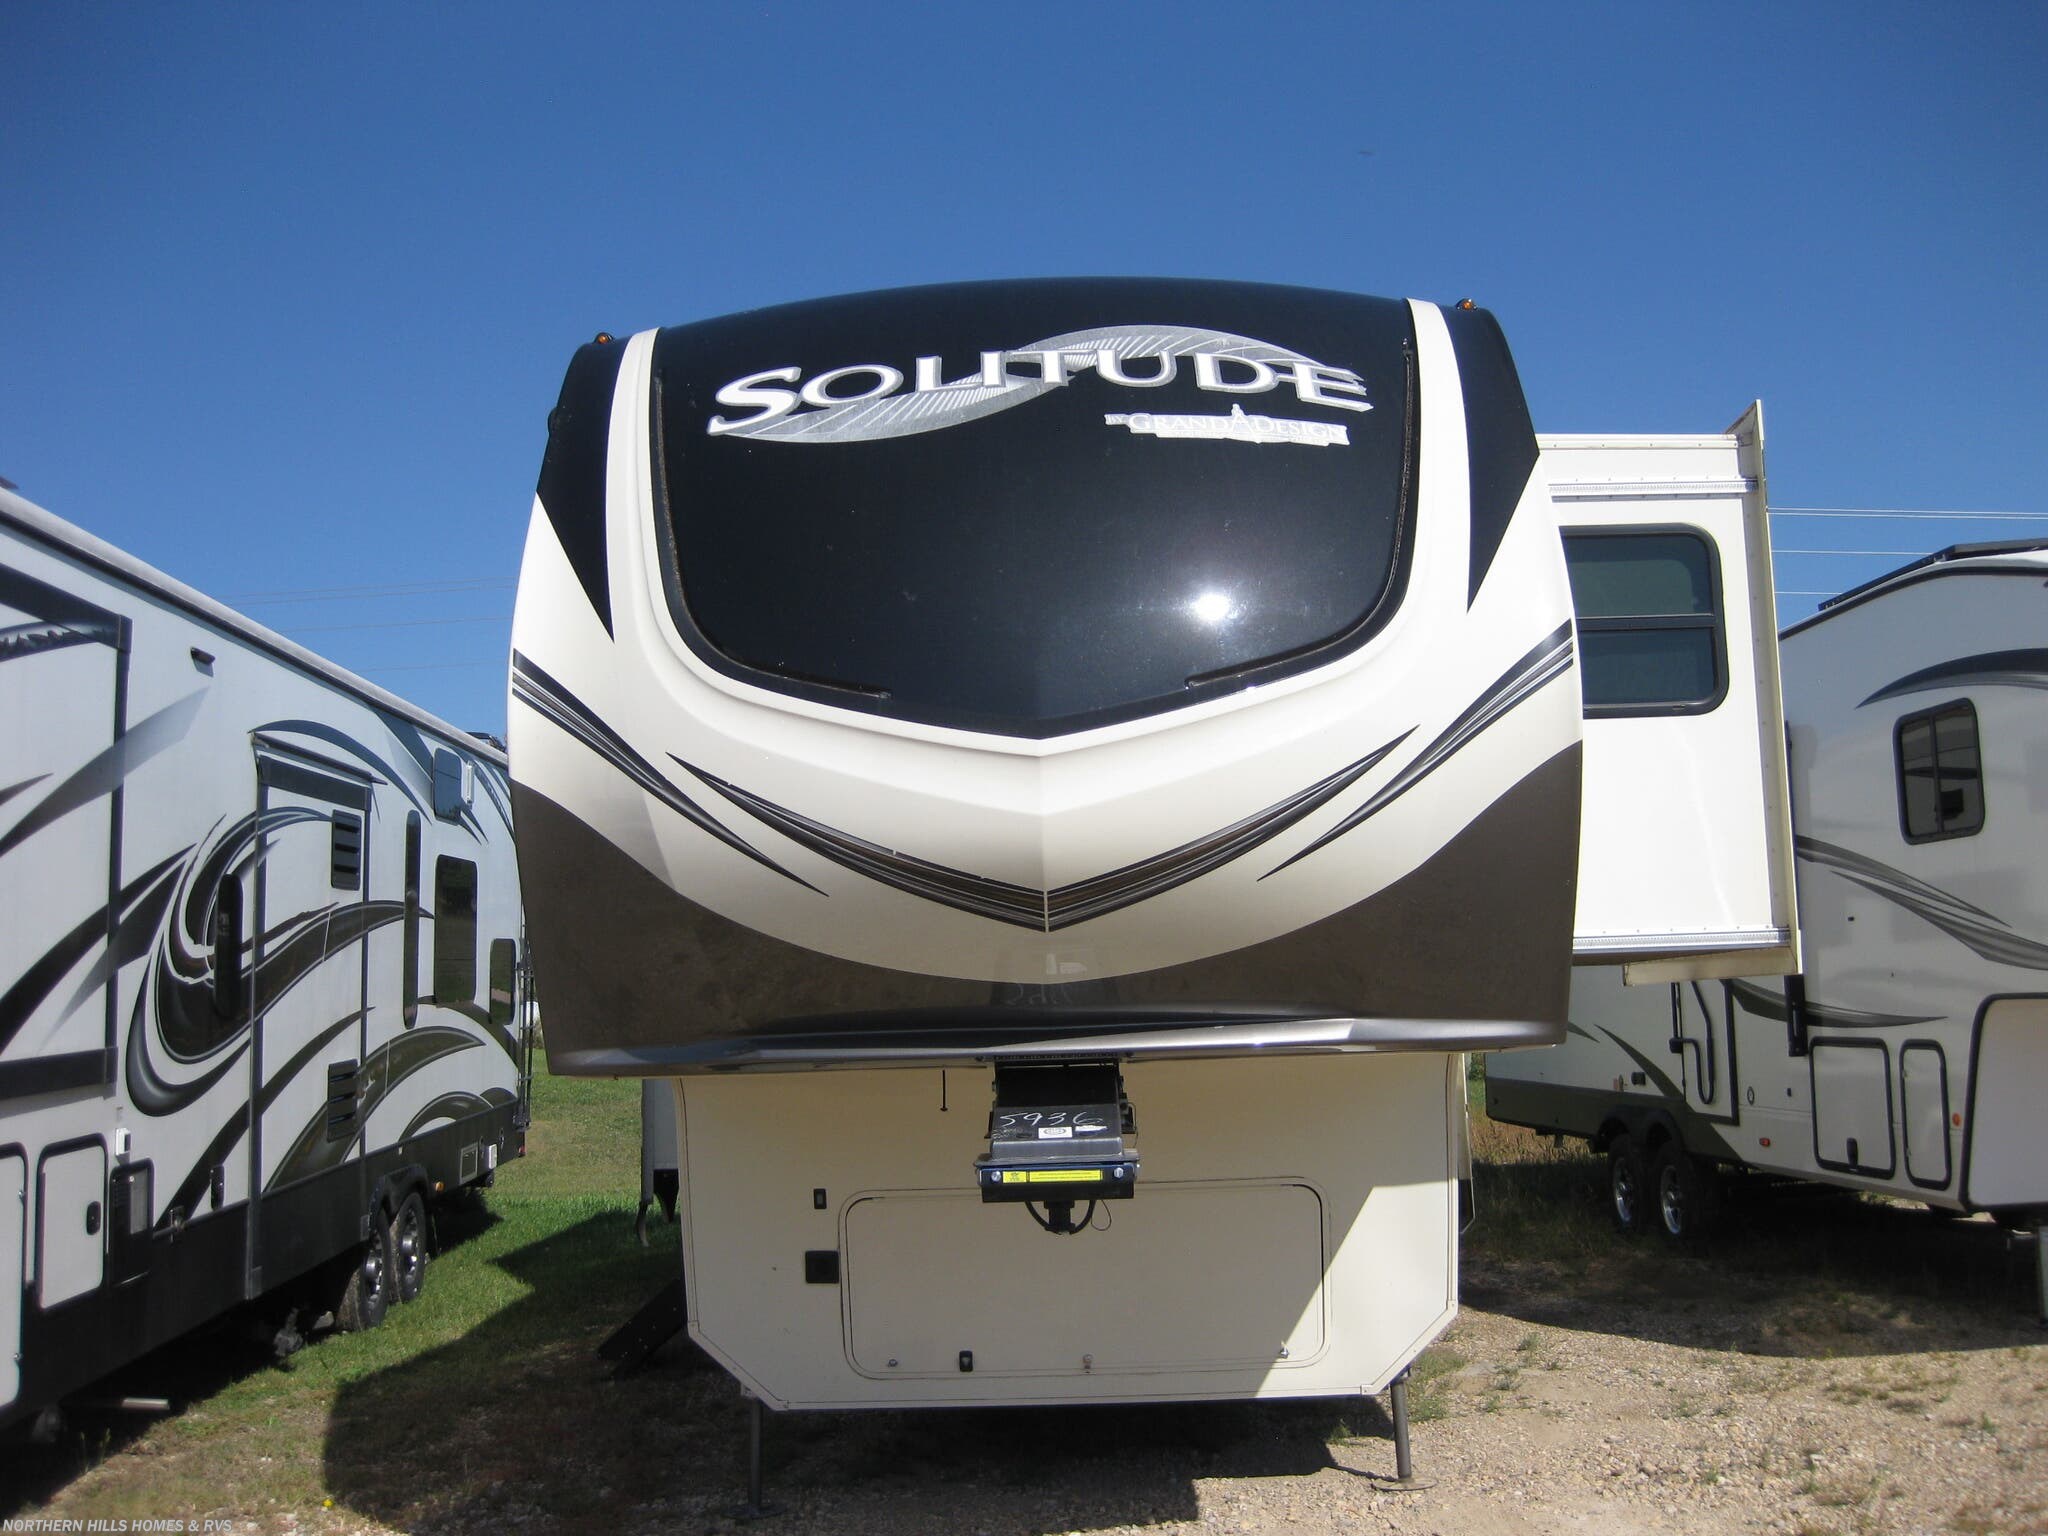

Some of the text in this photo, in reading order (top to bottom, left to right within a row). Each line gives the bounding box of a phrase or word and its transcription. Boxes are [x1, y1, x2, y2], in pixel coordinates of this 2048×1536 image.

[707, 348, 1374, 436] SOLITUDE
[1128, 413, 1230, 431] GRAND
[1254, 416, 1348, 439] DESIGN
[1000, 1112, 1103, 1127] 5936
